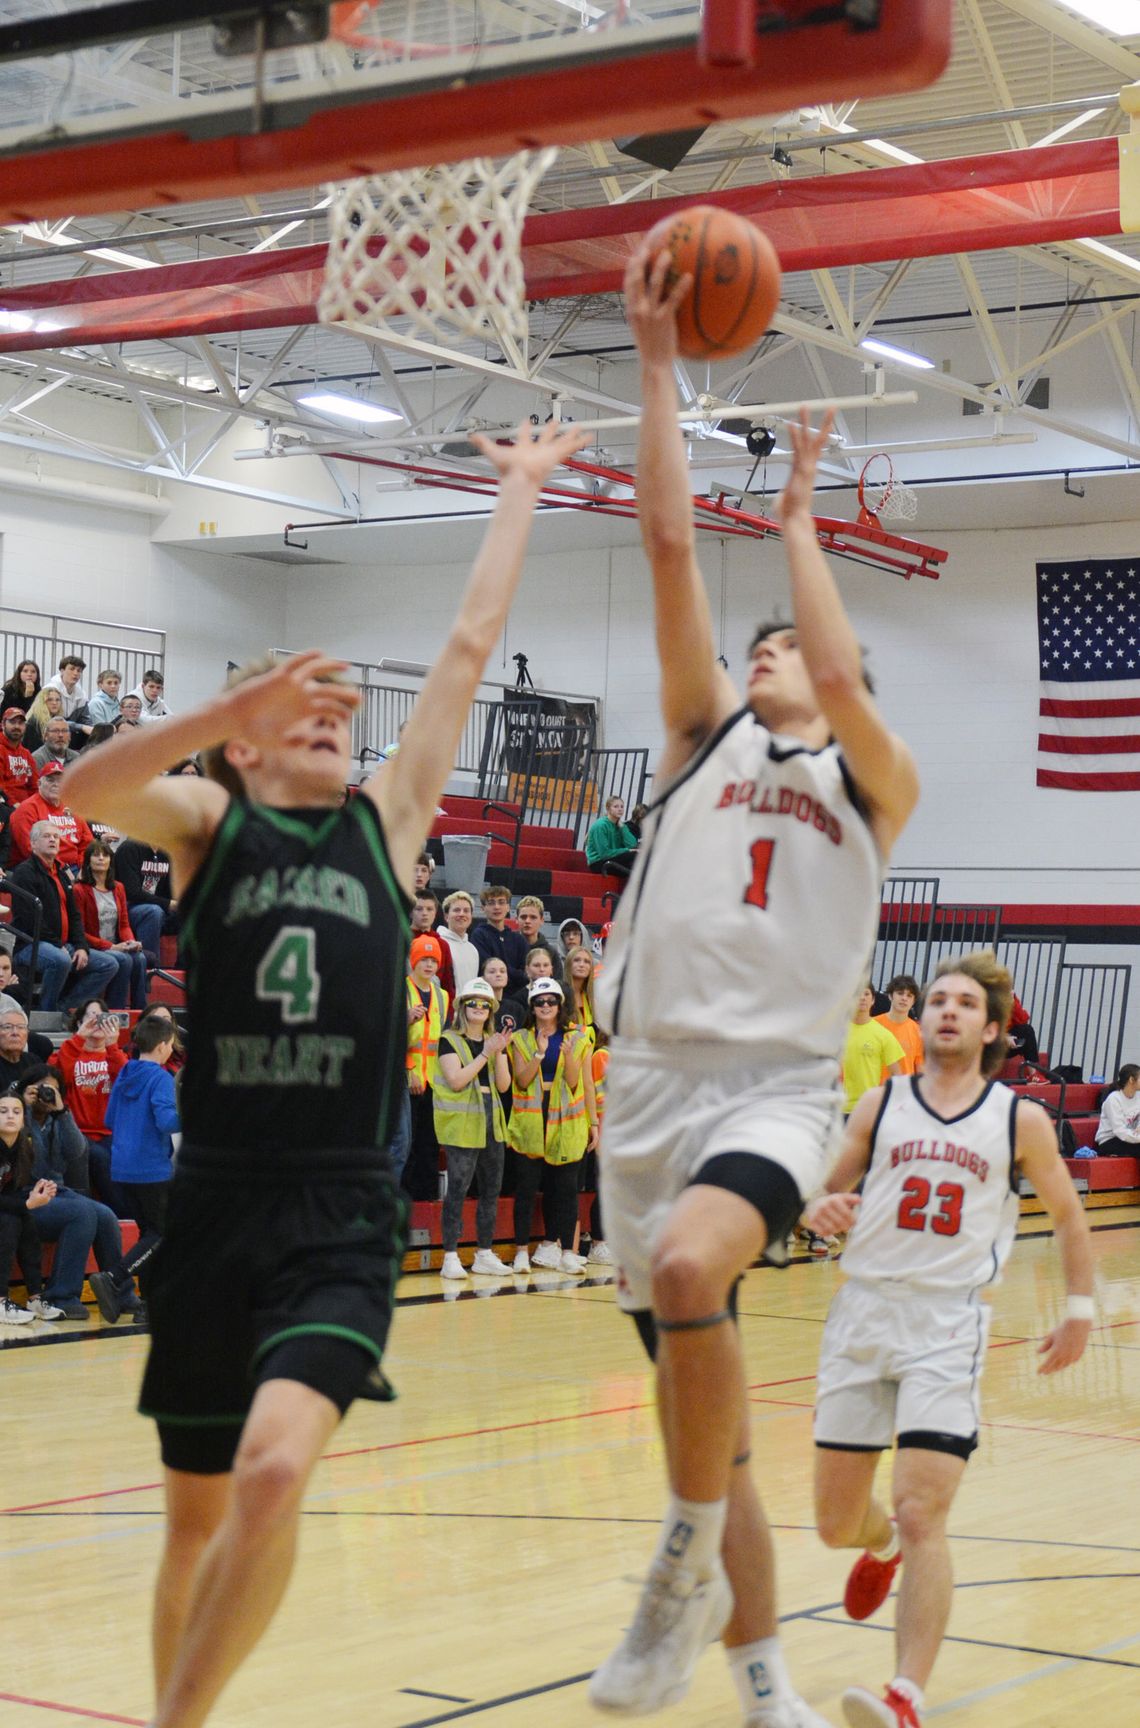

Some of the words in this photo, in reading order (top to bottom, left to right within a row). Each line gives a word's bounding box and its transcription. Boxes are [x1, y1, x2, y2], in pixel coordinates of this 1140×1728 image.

[715, 780, 843, 846] BULLDOGS
[742, 837, 776, 911] 1
[255, 924, 322, 1025] 4
[214, 1032, 357, 1088] HEART
[890, 1139, 990, 1183] BULLDOGS
[896, 1175, 965, 1237] 23
